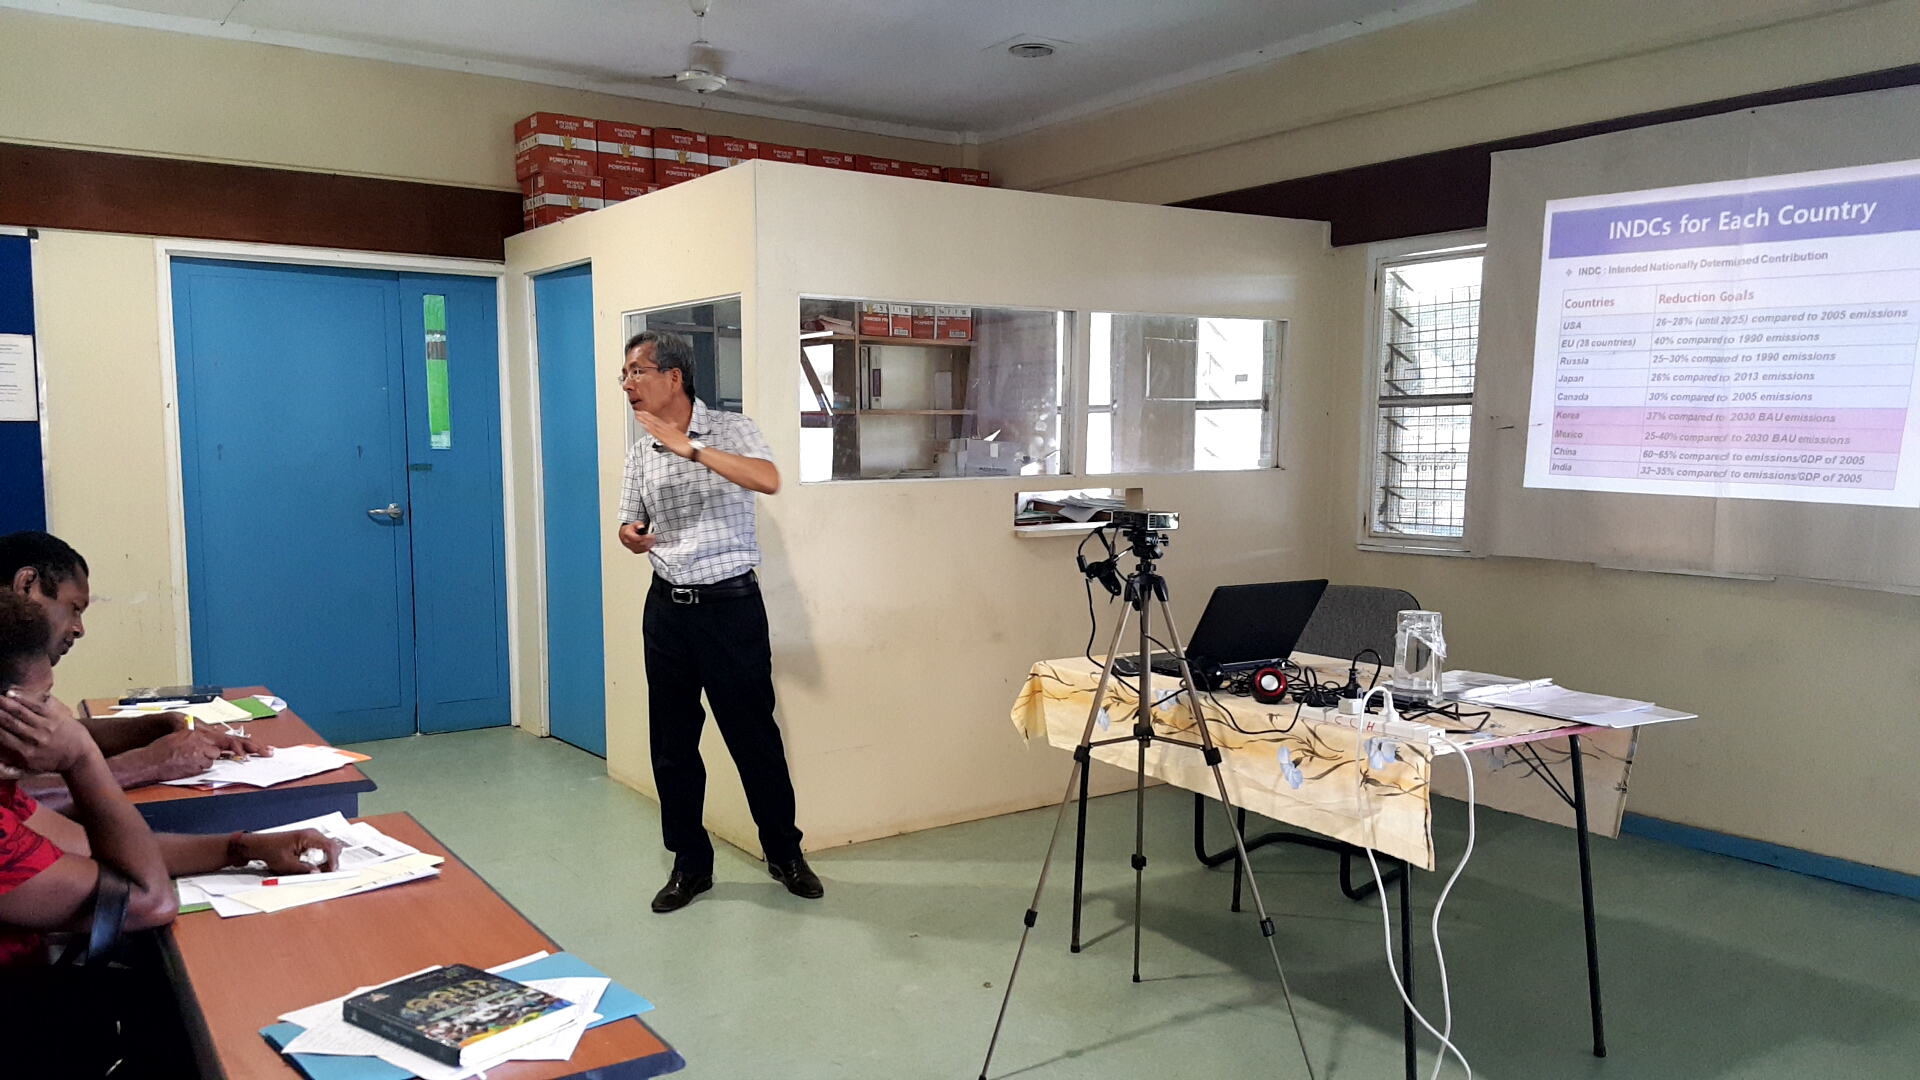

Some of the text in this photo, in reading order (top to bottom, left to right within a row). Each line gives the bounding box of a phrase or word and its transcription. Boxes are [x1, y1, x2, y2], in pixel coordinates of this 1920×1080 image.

[608, 164, 630, 172] POWDER
[1610, 200, 1878, 240] INDCs for Each Country
[1578, 266, 1602, 276] INDC
[1608, 264, 1648, 274] Intended
[1649, 260, 1698, 272] Nationally
[1700, 255, 1758, 268] Determined
[1761, 252, 1828, 264] Contribution
[1565, 297, 1615, 308] Countries
[1659, 290, 1754, 304] Reduction Goals
[1695, 316, 1719, 326] (until
[1752, 313, 1805, 324] compared
[1807, 313, 1818, 321] to
[1820, 310, 1846, 320] 2005
[1850, 308, 1908, 320] emissions
[1563, 322, 1581, 330] USA
[1561, 337, 1636, 349] EU (28 countries)
[1654, 332, 1820, 345] 40% compared to 1990 emissions
[1559, 357, 1589, 365] Russia
[1691, 354, 1738, 364] compared
[1741, 354, 1752, 362] to
[1756, 352, 1779, 361] 1990
[1782, 352, 1836, 361] emissions
[1558, 375, 1584, 384] Japan
[1651, 372, 1815, 383] 26% compared to 2013 emissions
[1557, 393, 1589, 401] Canada
[1649, 392, 1813, 402] 30% compared to 2005 emissions
[1556, 411, 1580, 419] Korea
[1646, 412, 1836, 422] 37% compared to 2030 BAU emissions
[1555, 430, 1583, 439] Mexico
[1679, 433, 1727, 443] compared
[1731, 434, 1742, 442] to
[1744, 434, 1768, 442] 2030
[1772, 434, 1796, 443] BAU
[1798, 434, 1850, 445] emissions
[1554, 447, 1577, 456] China
[1679, 452, 1730, 462] compared
[1732, 453, 1742, 461] to
[1745, 453, 1823, 464] emissions/GDP
[1824, 455, 1837, 464] of
[1839, 456, 1865, 465] 2005
[1552, 463, 1572, 471] India
[1676, 469, 1727, 479] compared
[1731, 470, 1741, 478] to
[1743, 470, 1820, 482] emissions/GDP
[1823, 472, 1835, 482] of
[1837, 473, 1862, 483] 2005
